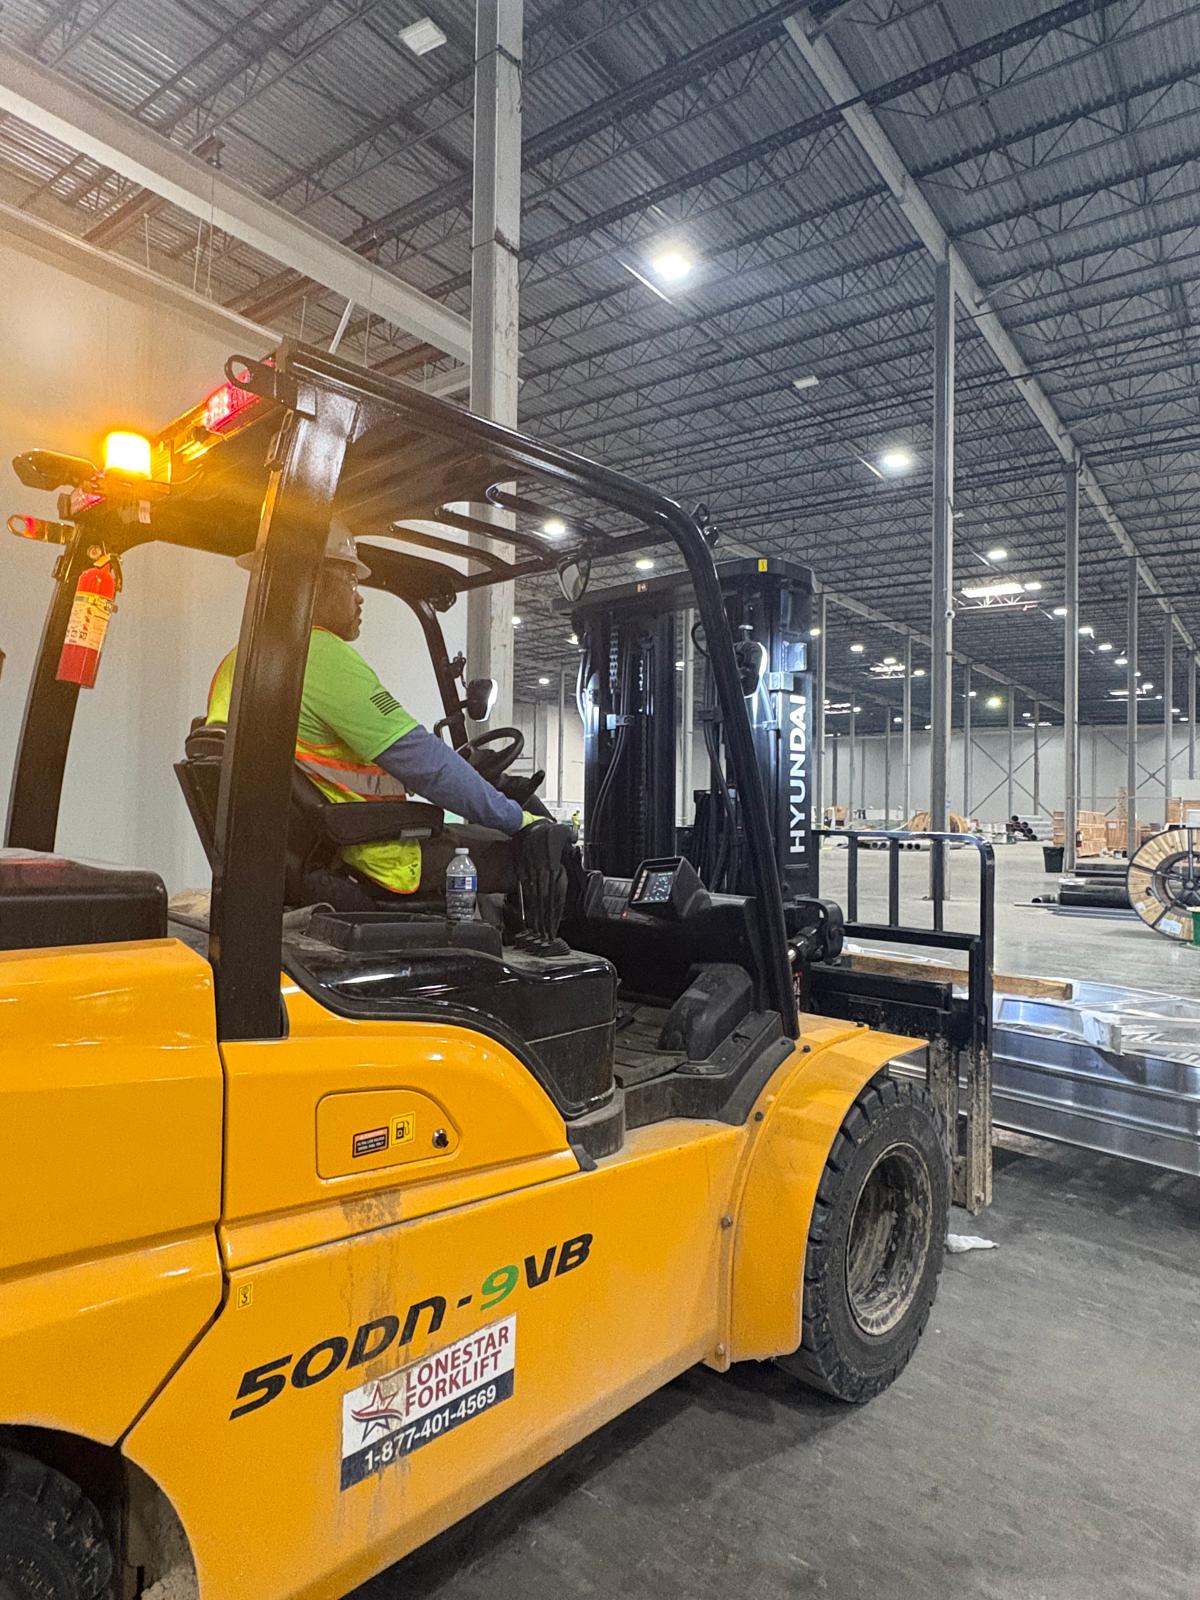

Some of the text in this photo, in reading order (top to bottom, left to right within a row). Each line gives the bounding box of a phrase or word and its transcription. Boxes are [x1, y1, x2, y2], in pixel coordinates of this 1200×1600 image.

[789, 694, 806, 854] HYUNDAI
[405, 1350, 502, 1416] FORKLIFT
[406, 1326, 509, 1392] LONESTAR
[364, 1384, 497, 1470] 1-877-401-4569
